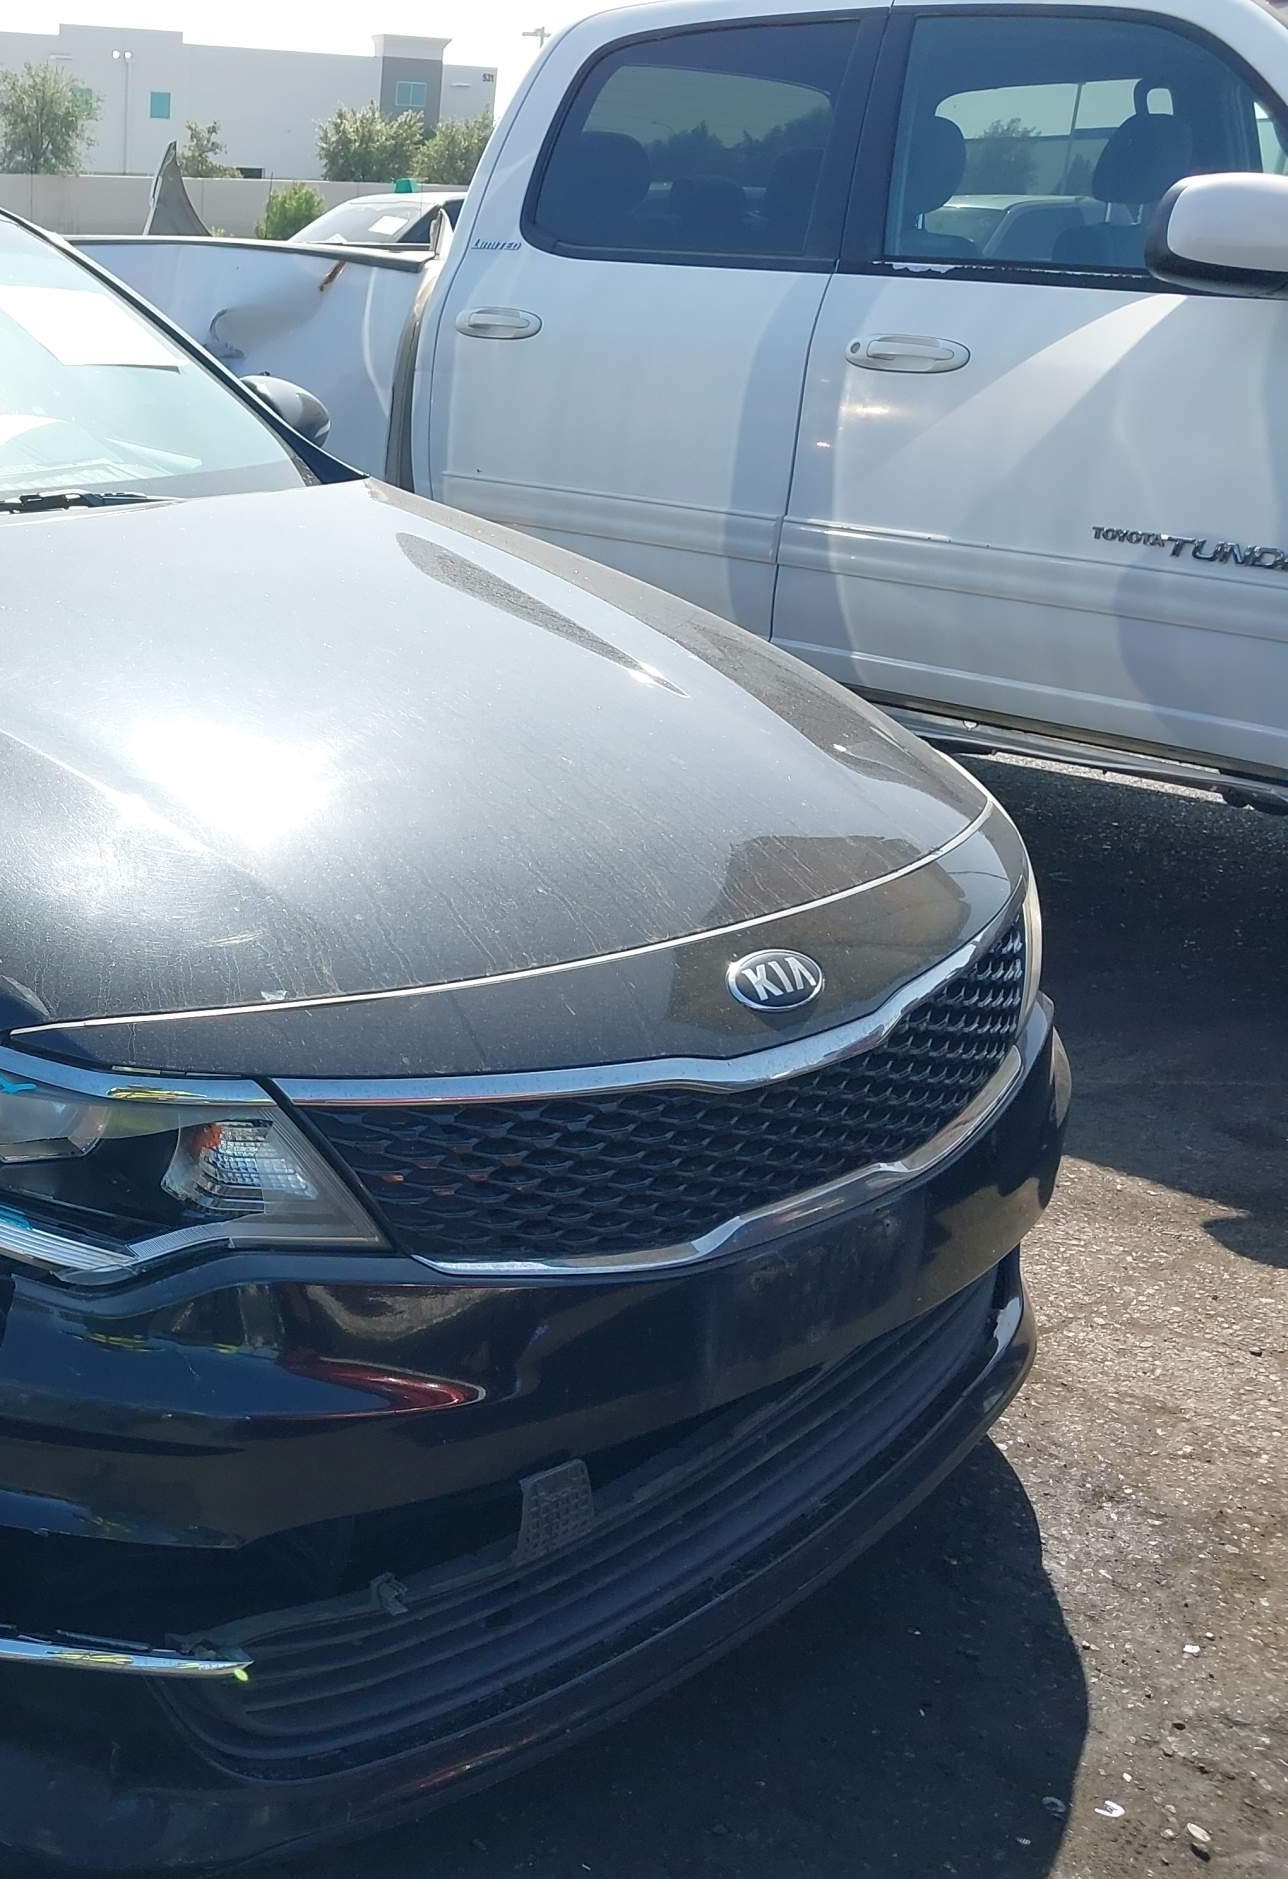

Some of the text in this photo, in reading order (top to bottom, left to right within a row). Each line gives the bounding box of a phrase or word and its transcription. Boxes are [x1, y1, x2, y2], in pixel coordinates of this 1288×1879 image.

[1092, 526, 1288, 571] TOYOTA TUND
[741, 956, 817, 1001] KIA
